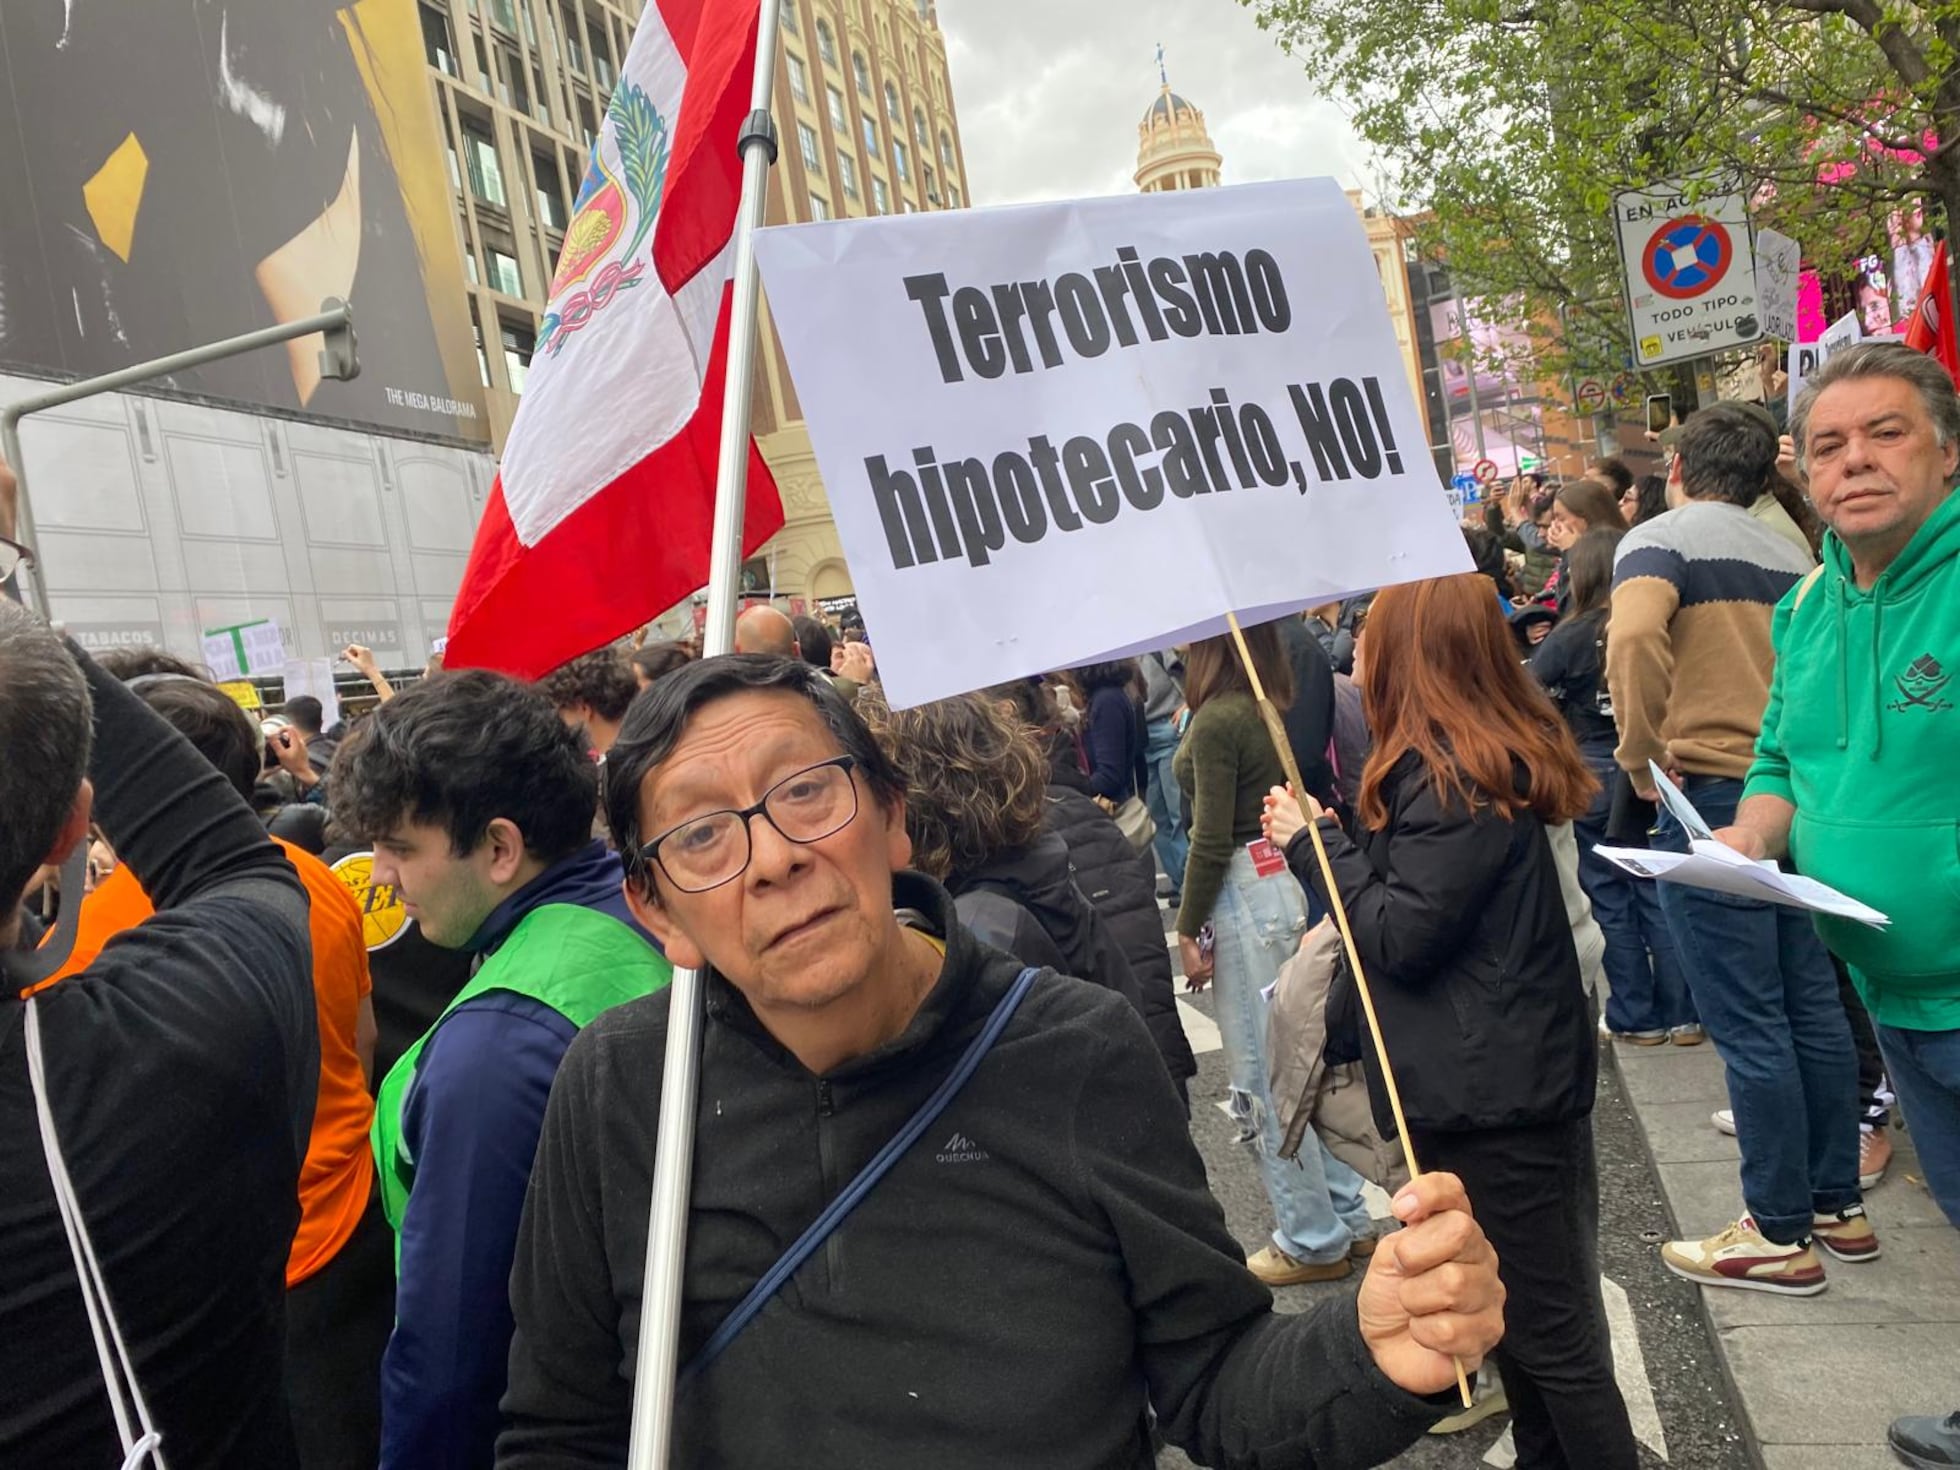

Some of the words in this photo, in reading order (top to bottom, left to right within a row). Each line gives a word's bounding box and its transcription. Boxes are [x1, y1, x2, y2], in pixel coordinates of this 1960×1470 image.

[1626, 201, 1653, 222] EN
[902, 245, 1293, 384] Terrorismo
[1651, 305, 1694, 325] TODO
[1702, 294, 1738, 313] TIPO
[384, 386, 405, 407] THE
[404, 390, 431, 412] MEGA
[429, 394, 477, 420] BALORAMA
[863, 388, 1308, 570] hipotecario,
[1286, 377, 1406, 482] NO!
[77, 630, 154, 647] TABACOS
[935, 1150, 990, 1163] QUECHUA
